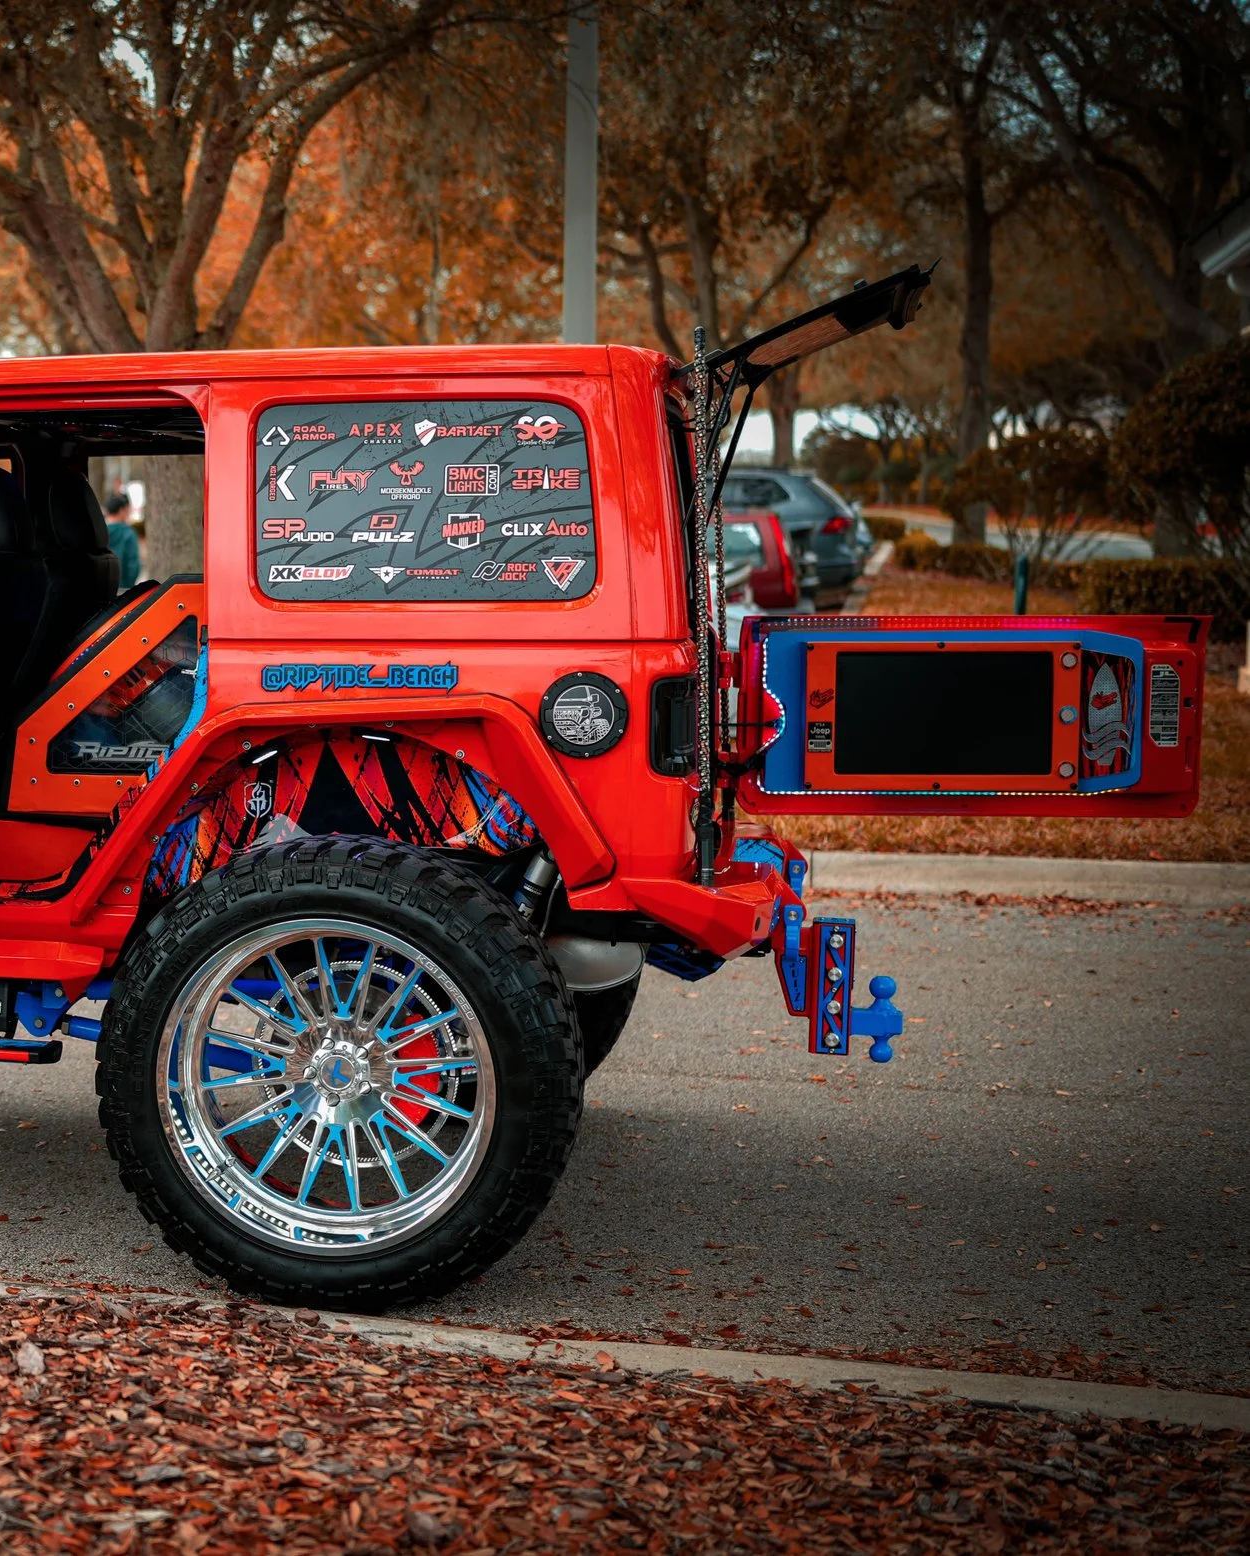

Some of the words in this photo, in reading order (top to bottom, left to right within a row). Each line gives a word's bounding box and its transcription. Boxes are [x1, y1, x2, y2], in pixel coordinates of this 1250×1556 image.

[293, 425, 326, 433] ROAD
[349, 423, 403, 437] APEX
[436, 425, 503, 437] BARTACT
[293, 433, 336, 441] ARMOR
[449, 468, 486, 480] BMC
[512, 468, 580, 479] TRUE
[310, 469, 373, 491] FURY
[489, 469, 498, 491] .COM
[512, 479, 580, 490] SPIKE
[448, 481, 485, 493] LIGHTS
[262, 519, 306, 539] SP
[442, 519, 485, 538] MAXXED
[501, 523, 544, 536] CLIX
[544, 519, 589, 536] Auto
[288, 531, 335, 542] AUDIO
[507, 563, 536, 571] ROCK
[498, 572, 526, 581] JOCK
[810, 727, 830, 735] Jeep
[437, 973, 475, 1020] FORGED
